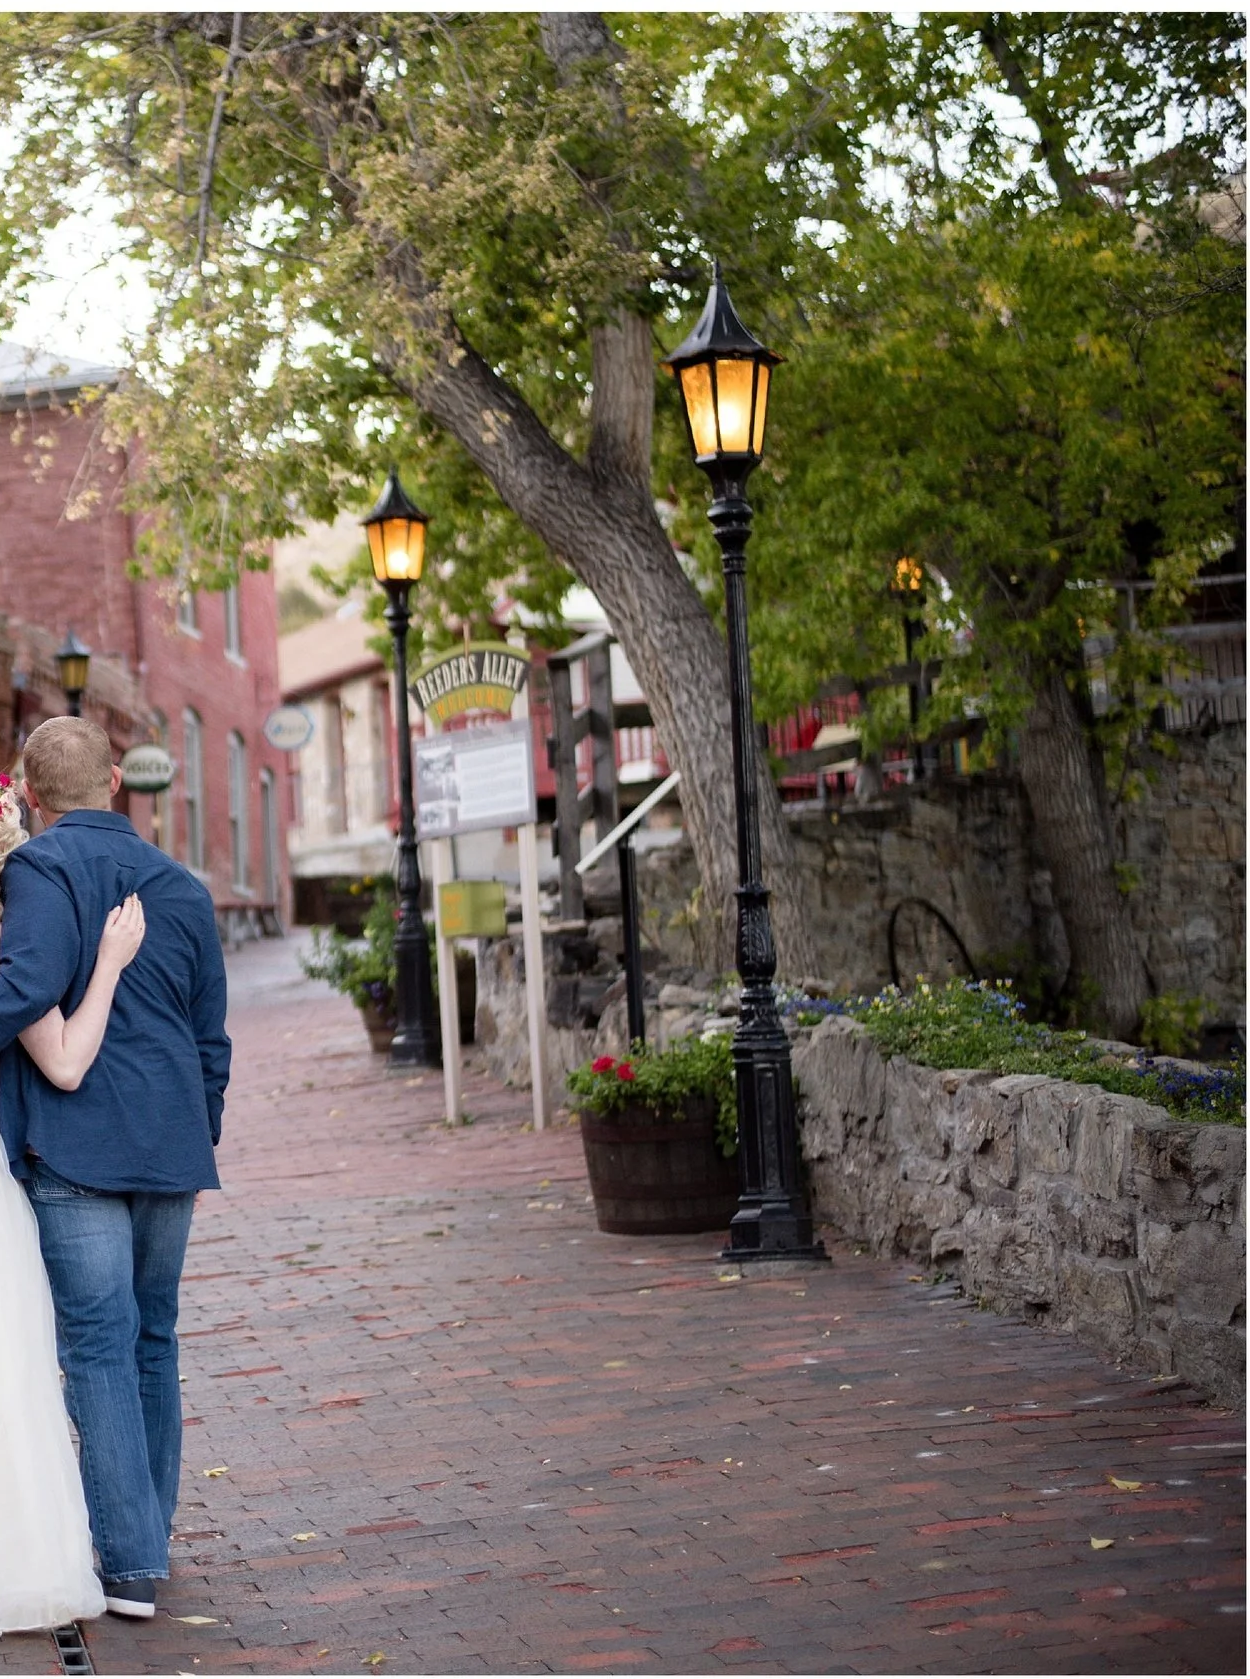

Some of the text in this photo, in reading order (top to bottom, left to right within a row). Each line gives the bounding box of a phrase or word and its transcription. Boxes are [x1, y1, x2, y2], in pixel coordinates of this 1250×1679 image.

[416, 650, 525, 707] REEDERS ALLEY
[435, 688, 506, 717] WELCOME
